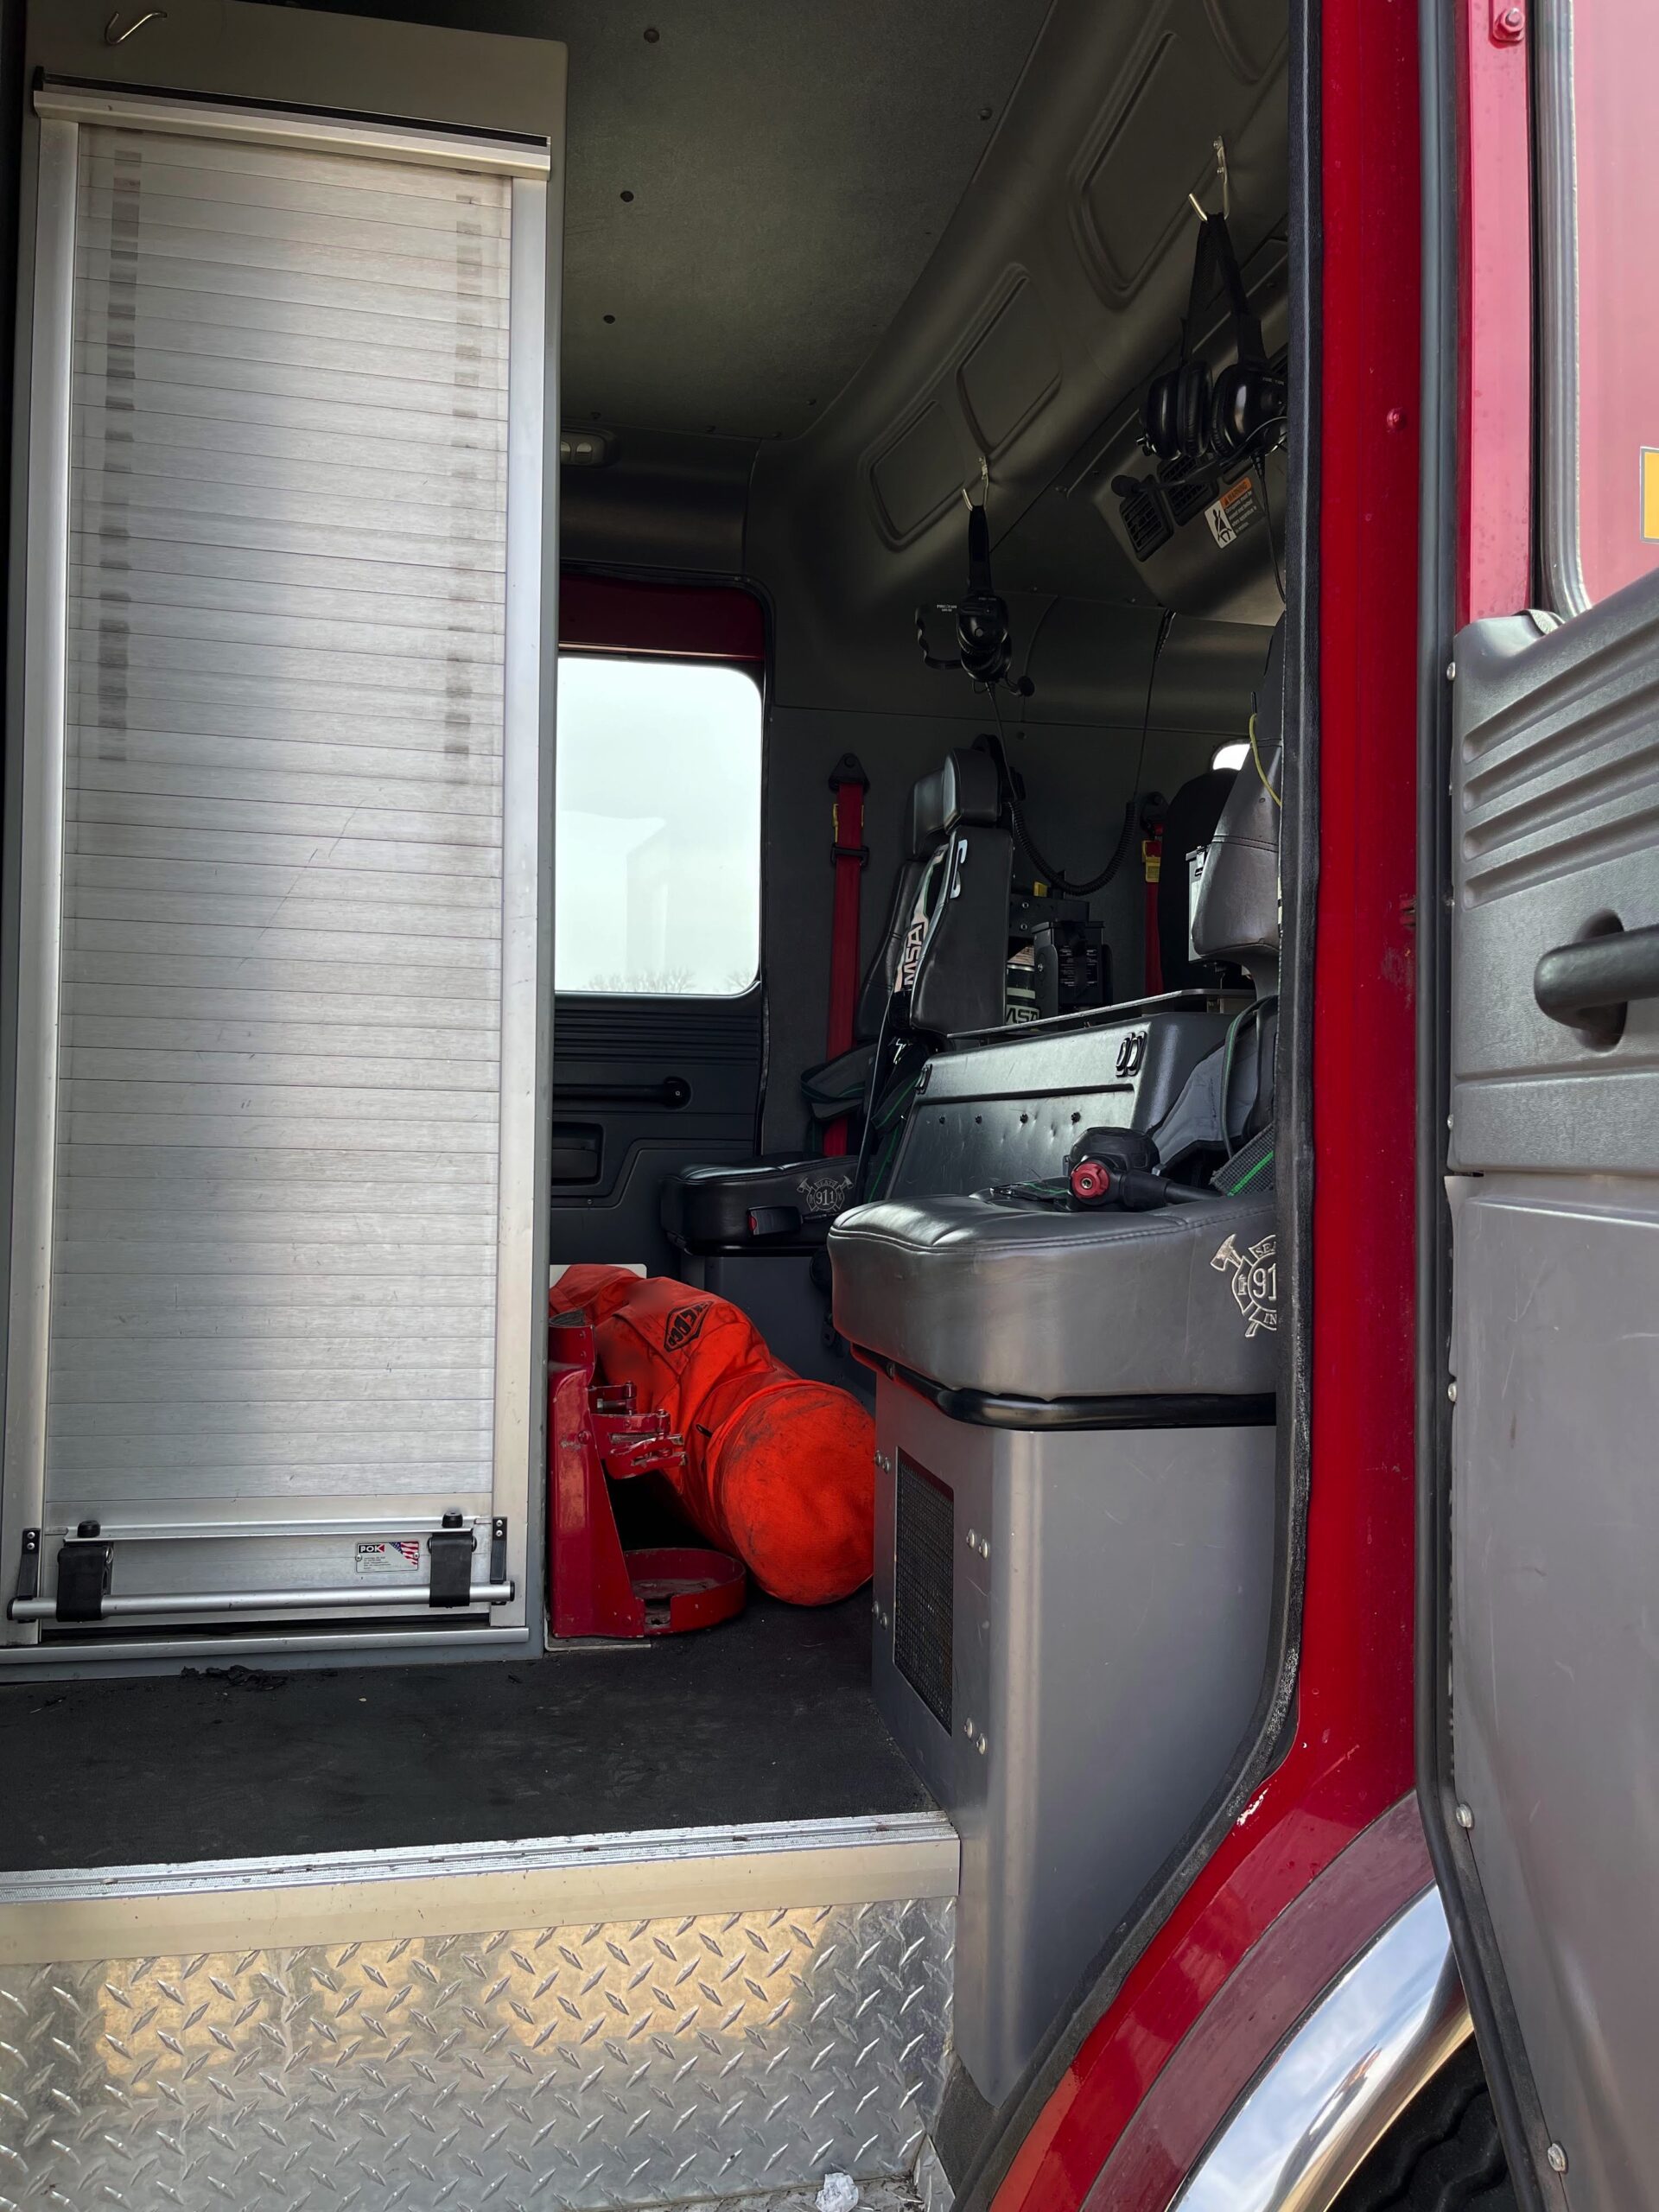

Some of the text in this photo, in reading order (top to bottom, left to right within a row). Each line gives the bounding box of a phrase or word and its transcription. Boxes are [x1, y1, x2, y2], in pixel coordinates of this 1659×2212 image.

[903, 924, 925, 987] MSA
[816, 1189, 836, 1206] 911
[359, 1544, 385, 1554] POK
